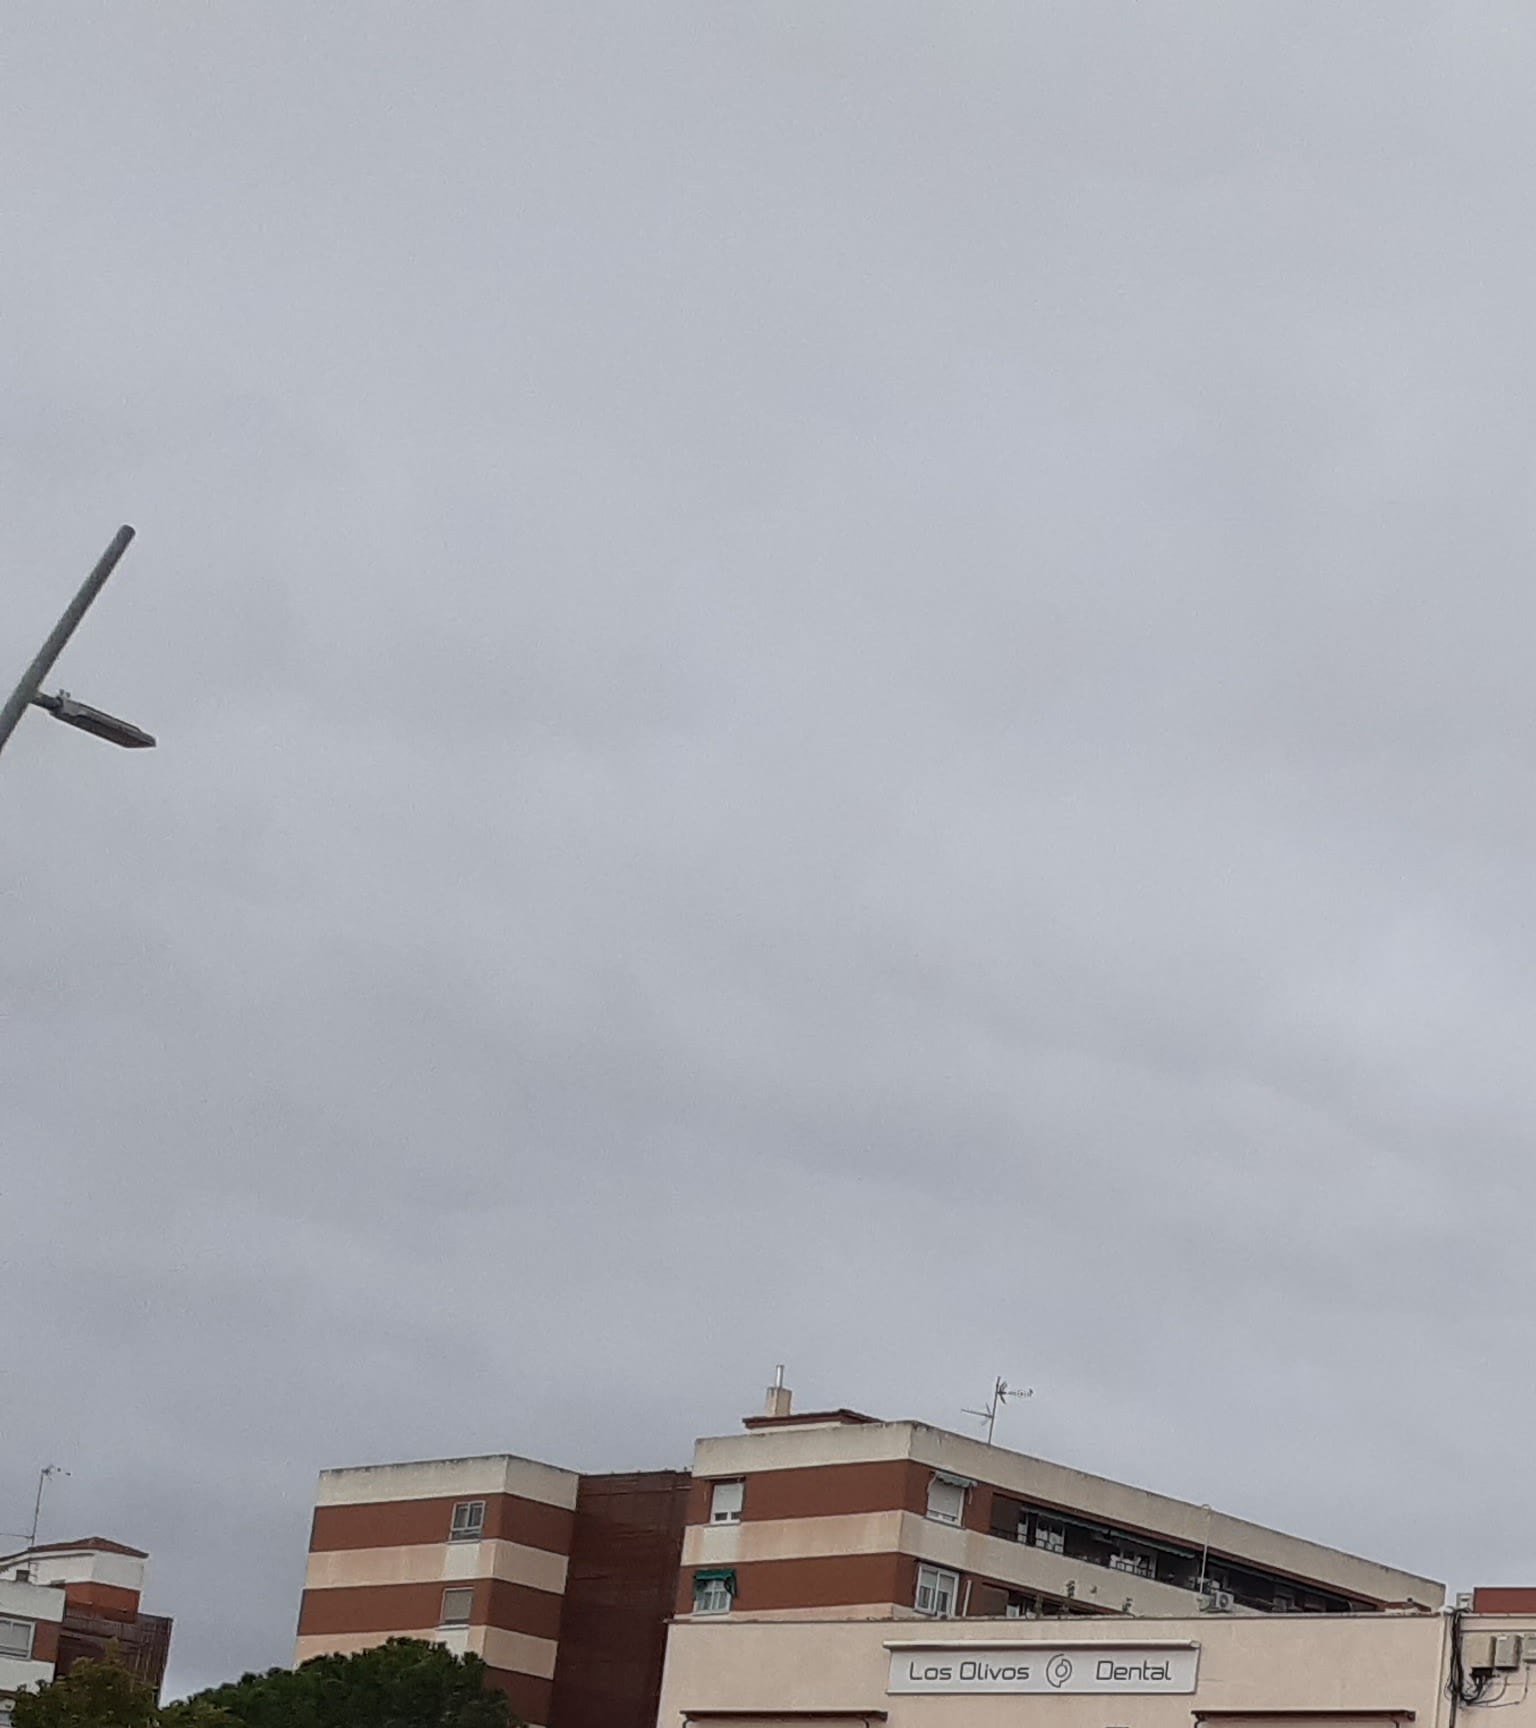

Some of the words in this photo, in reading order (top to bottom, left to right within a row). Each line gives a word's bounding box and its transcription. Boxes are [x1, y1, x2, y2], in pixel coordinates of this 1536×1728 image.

[909, 1661, 952, 1681] Los
[959, 1661, 1029, 1681] Olivos
[1096, 1660, 1172, 1681] Dental
